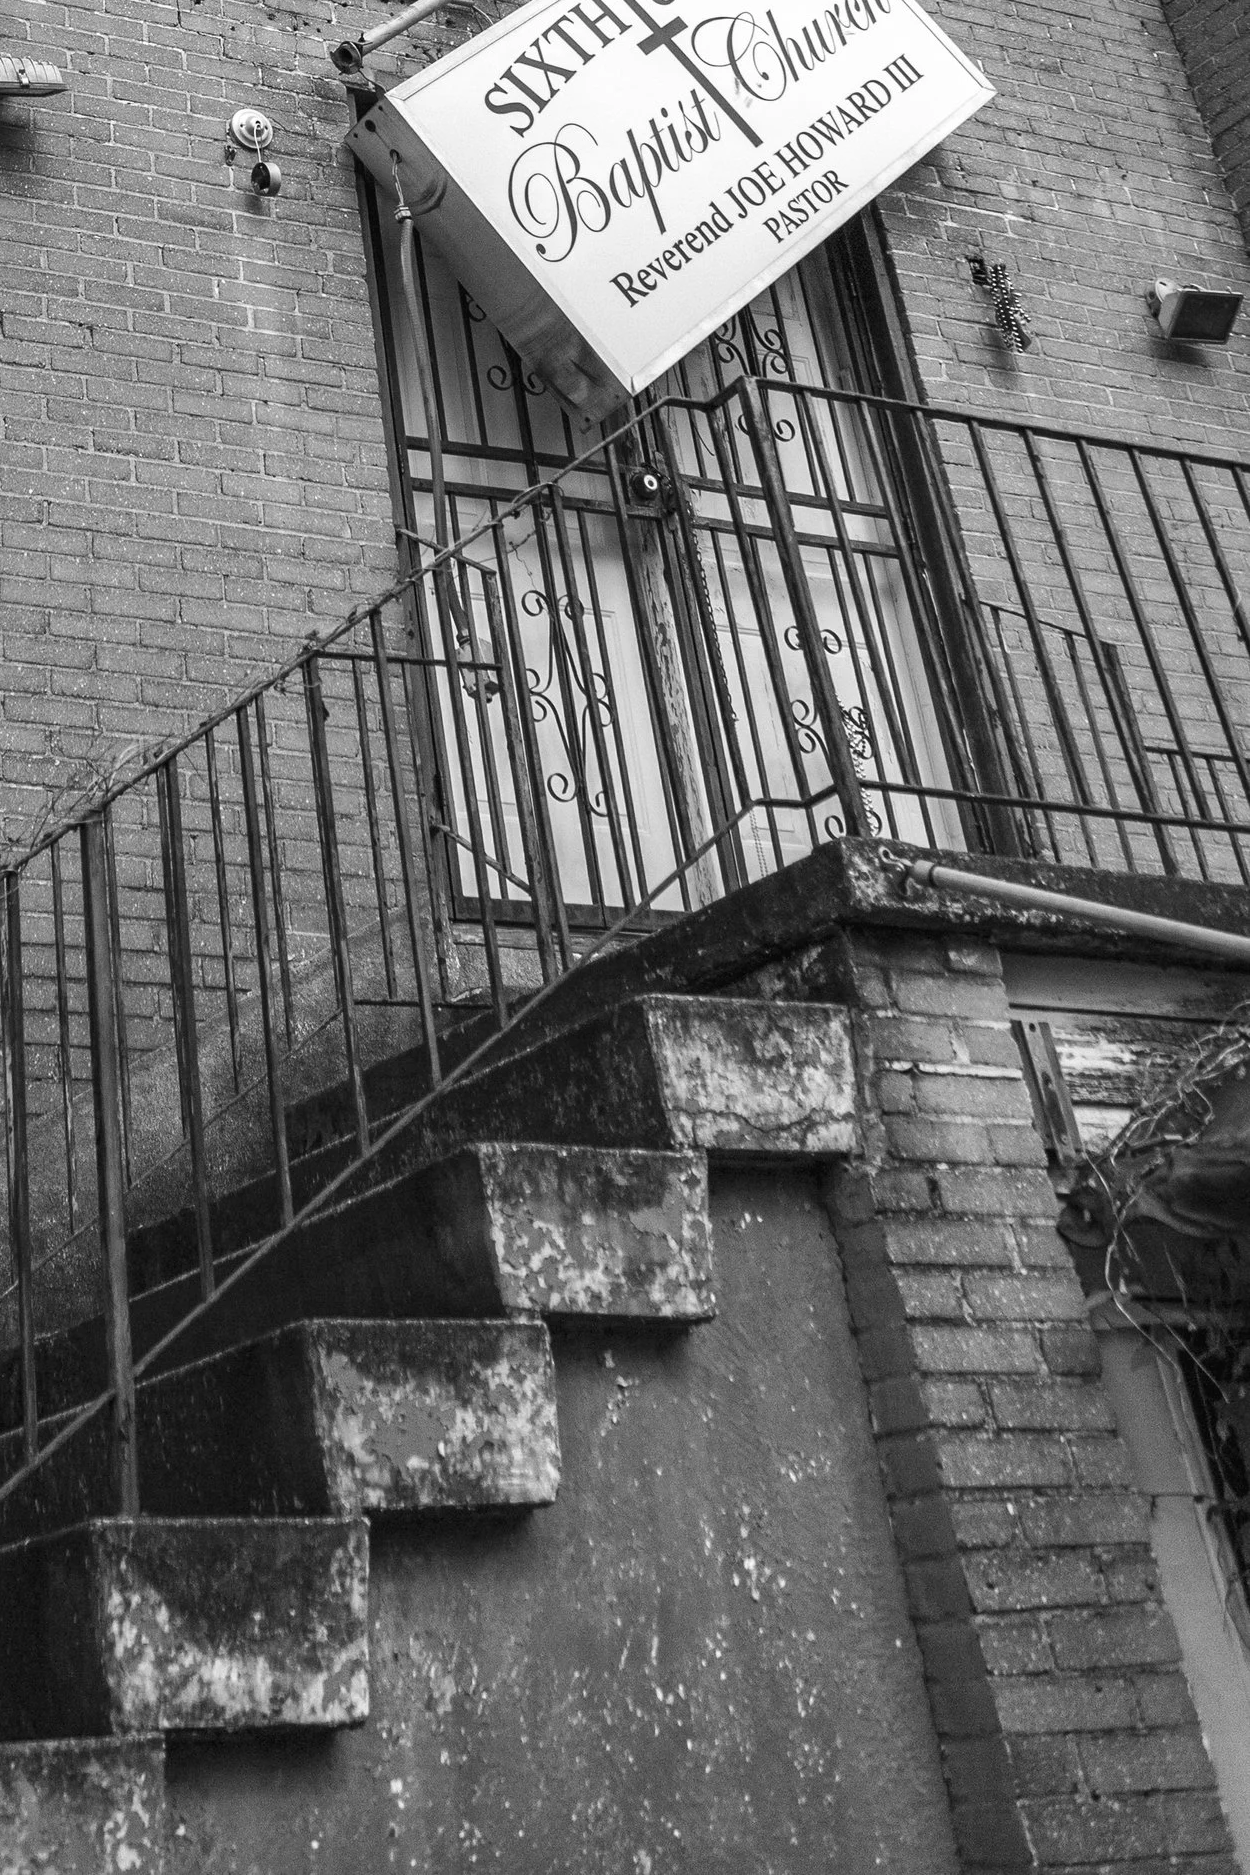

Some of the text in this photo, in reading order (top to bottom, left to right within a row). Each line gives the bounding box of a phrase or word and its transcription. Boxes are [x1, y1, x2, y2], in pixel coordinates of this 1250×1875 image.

[507, 88, 723, 263] Baptist
[609, 54, 924, 308] Reverend JOE HOWARD III
[762, 170, 850, 244] PASTOR
